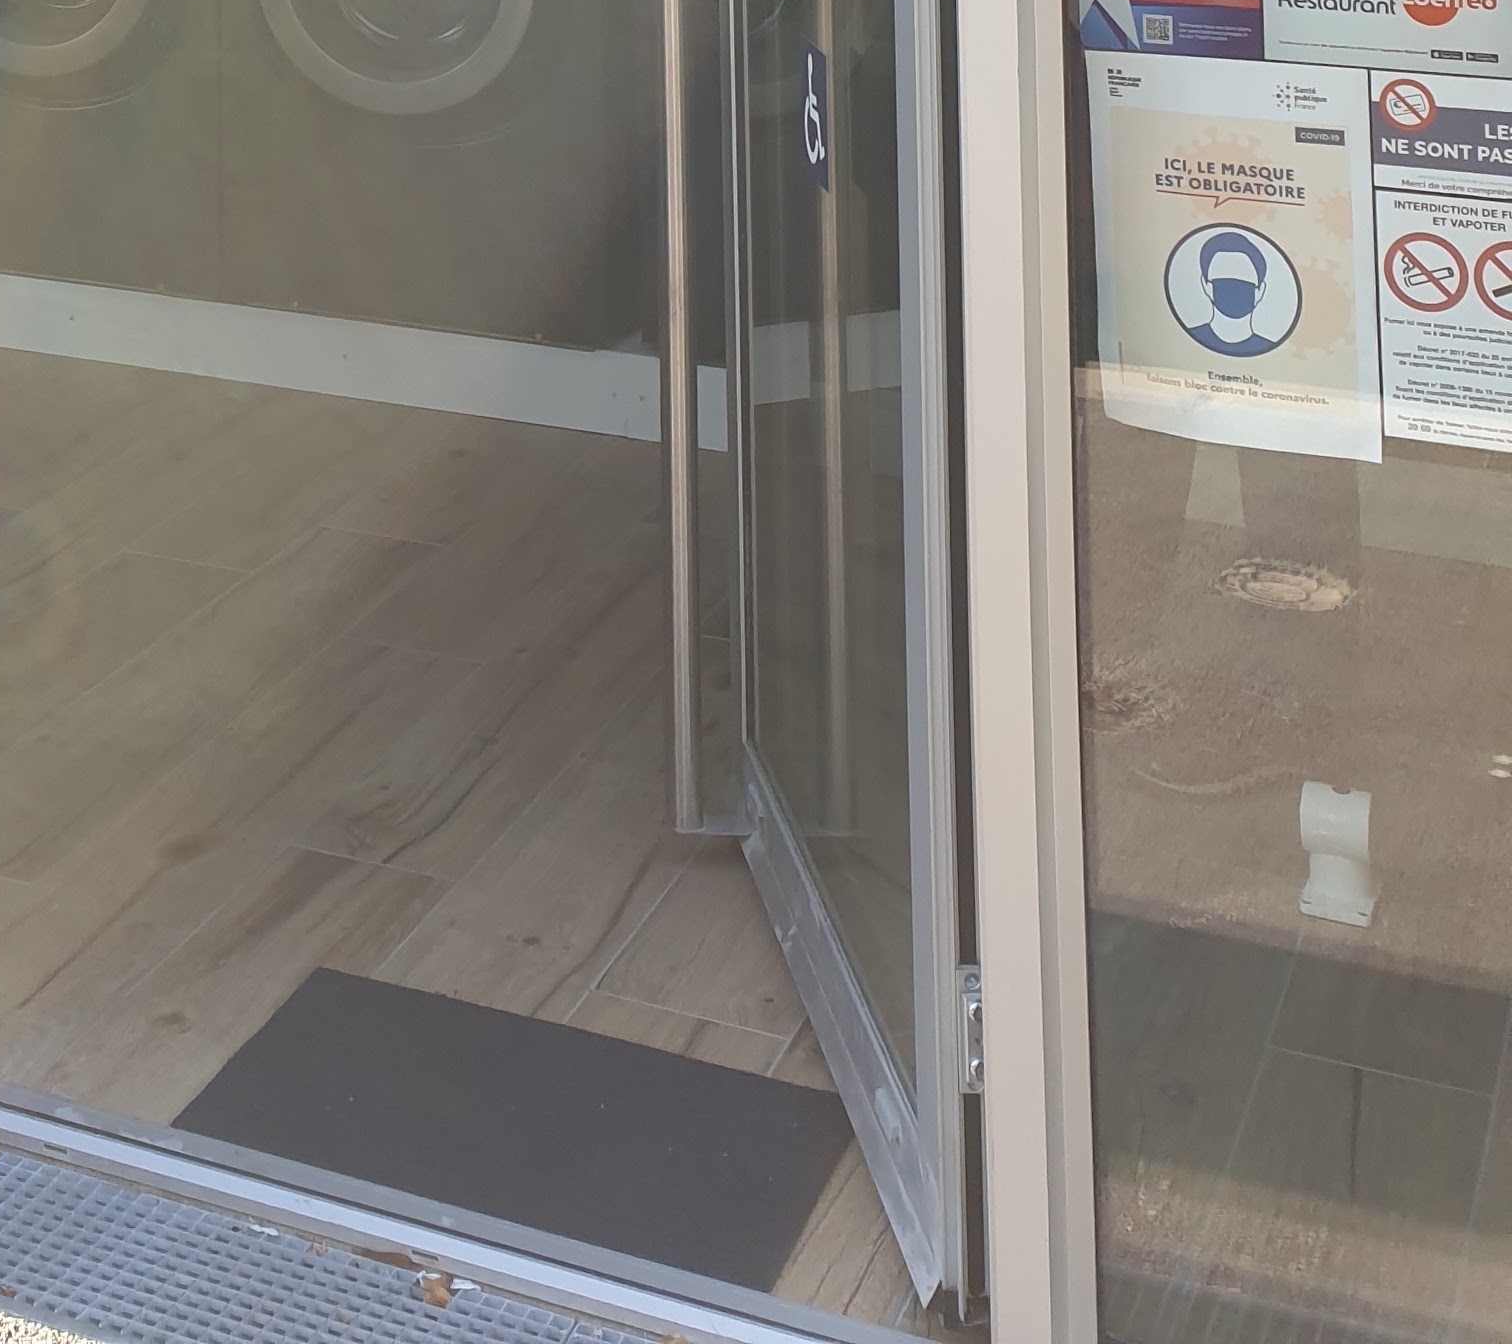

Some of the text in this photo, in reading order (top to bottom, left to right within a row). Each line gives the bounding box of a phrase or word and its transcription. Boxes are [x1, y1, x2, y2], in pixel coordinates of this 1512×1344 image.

[1300, 131, 1340, 142] COVID-19
[1380, 137, 1512, 165] NE SONT PAS
[1164, 158, 1295, 182] ICI, LE MASQUE
[1155, 173, 1306, 200] EST OBLIGATOIRE
[1401, 178, 1426, 189] Merci
[1394, 200, 1479, 217] INTERDICTION
[1481, 208, 1499, 219] DE
[1432, 216, 1507, 233] ET VAPOTER
